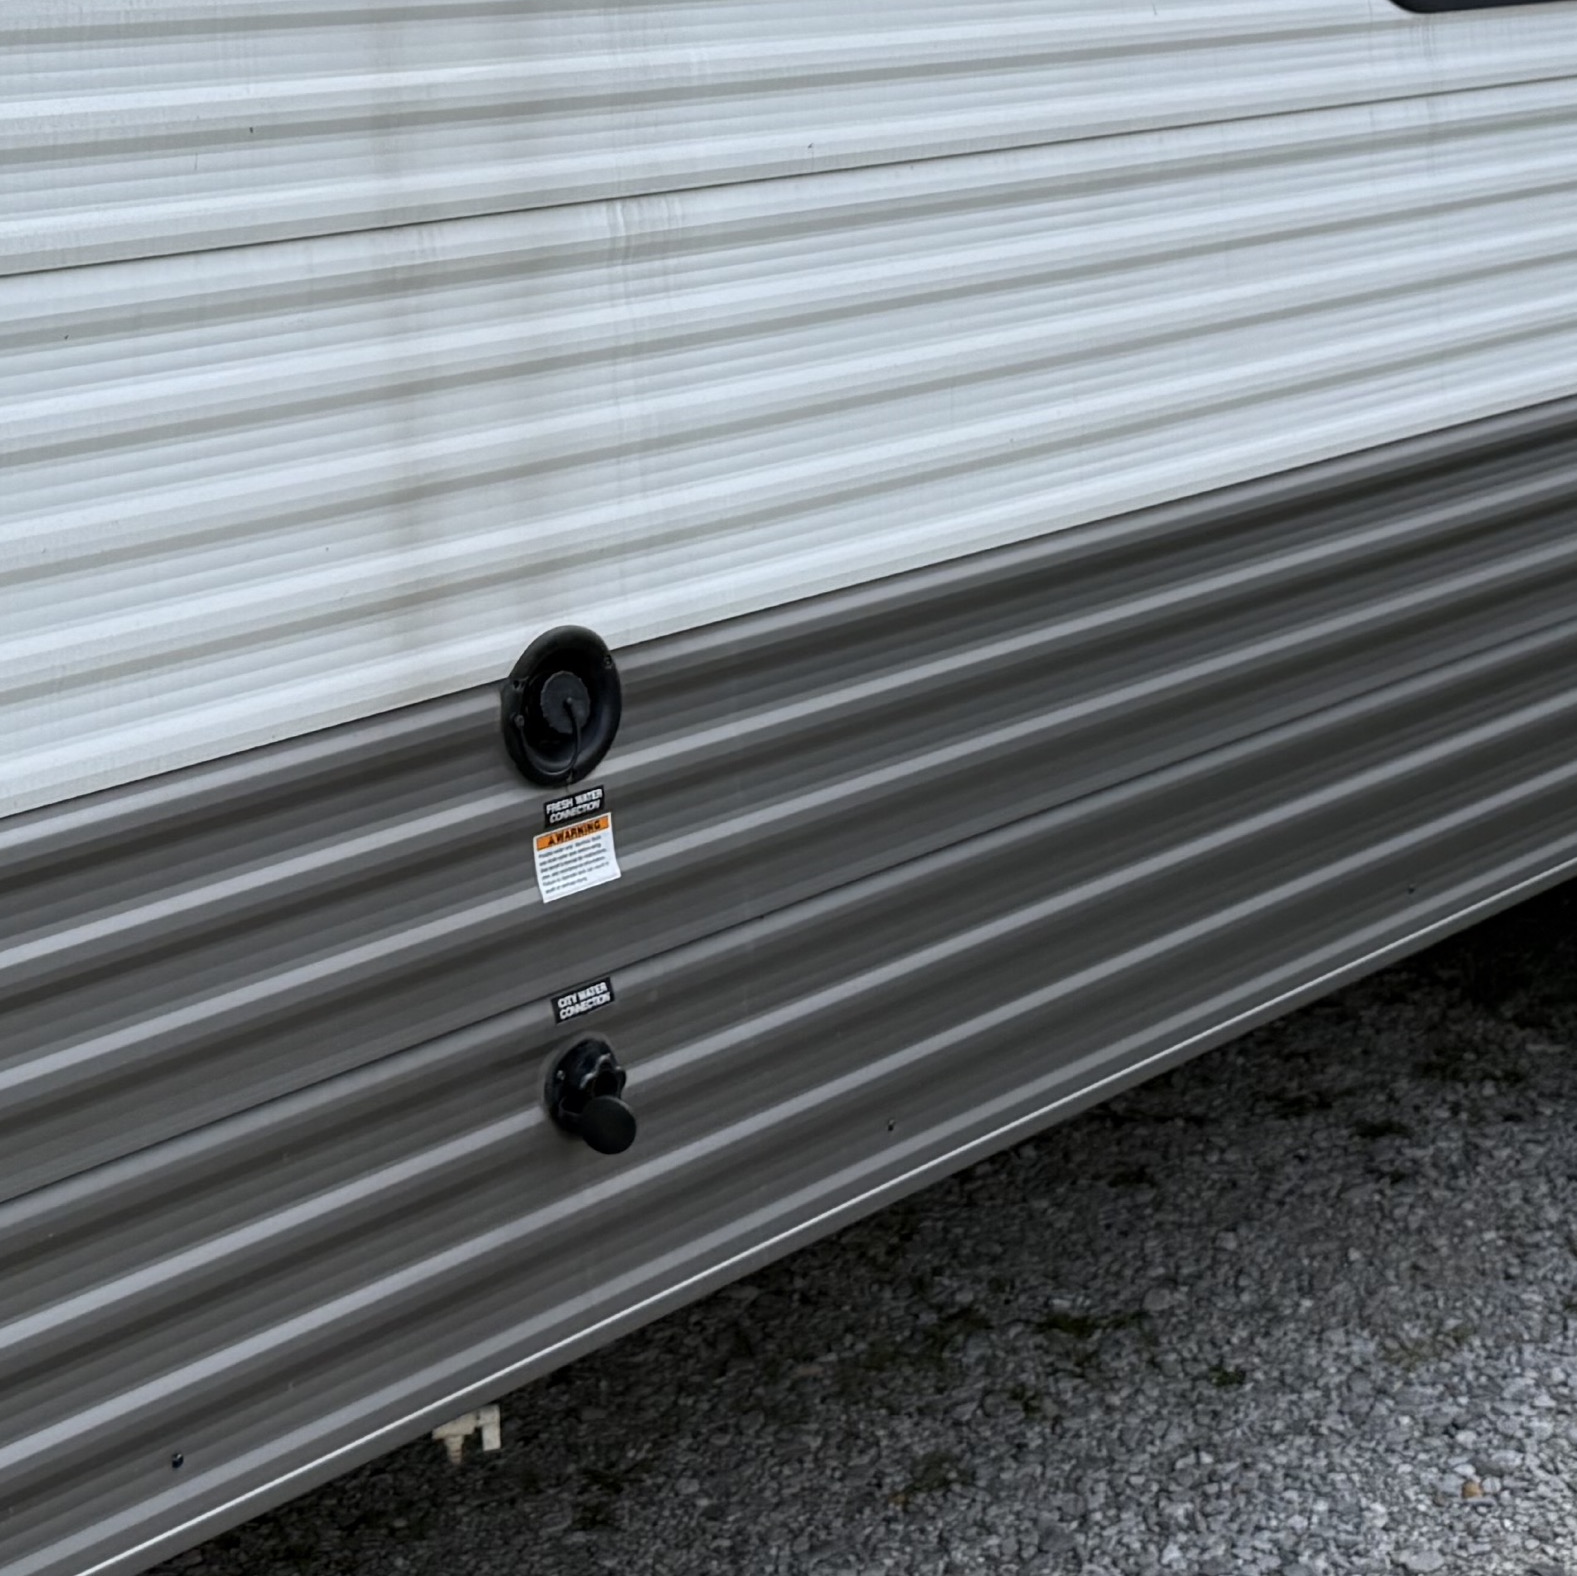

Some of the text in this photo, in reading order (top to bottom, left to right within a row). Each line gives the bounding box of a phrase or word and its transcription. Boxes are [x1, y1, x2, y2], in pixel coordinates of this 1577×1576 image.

[546, 798, 573, 815] FRESH
[549, 799, 600, 823] CONNECTION
[553, 820, 600, 843] WARNING
[557, 993, 577, 1008] CITY
[559, 992, 610, 1020] CONNECTION
